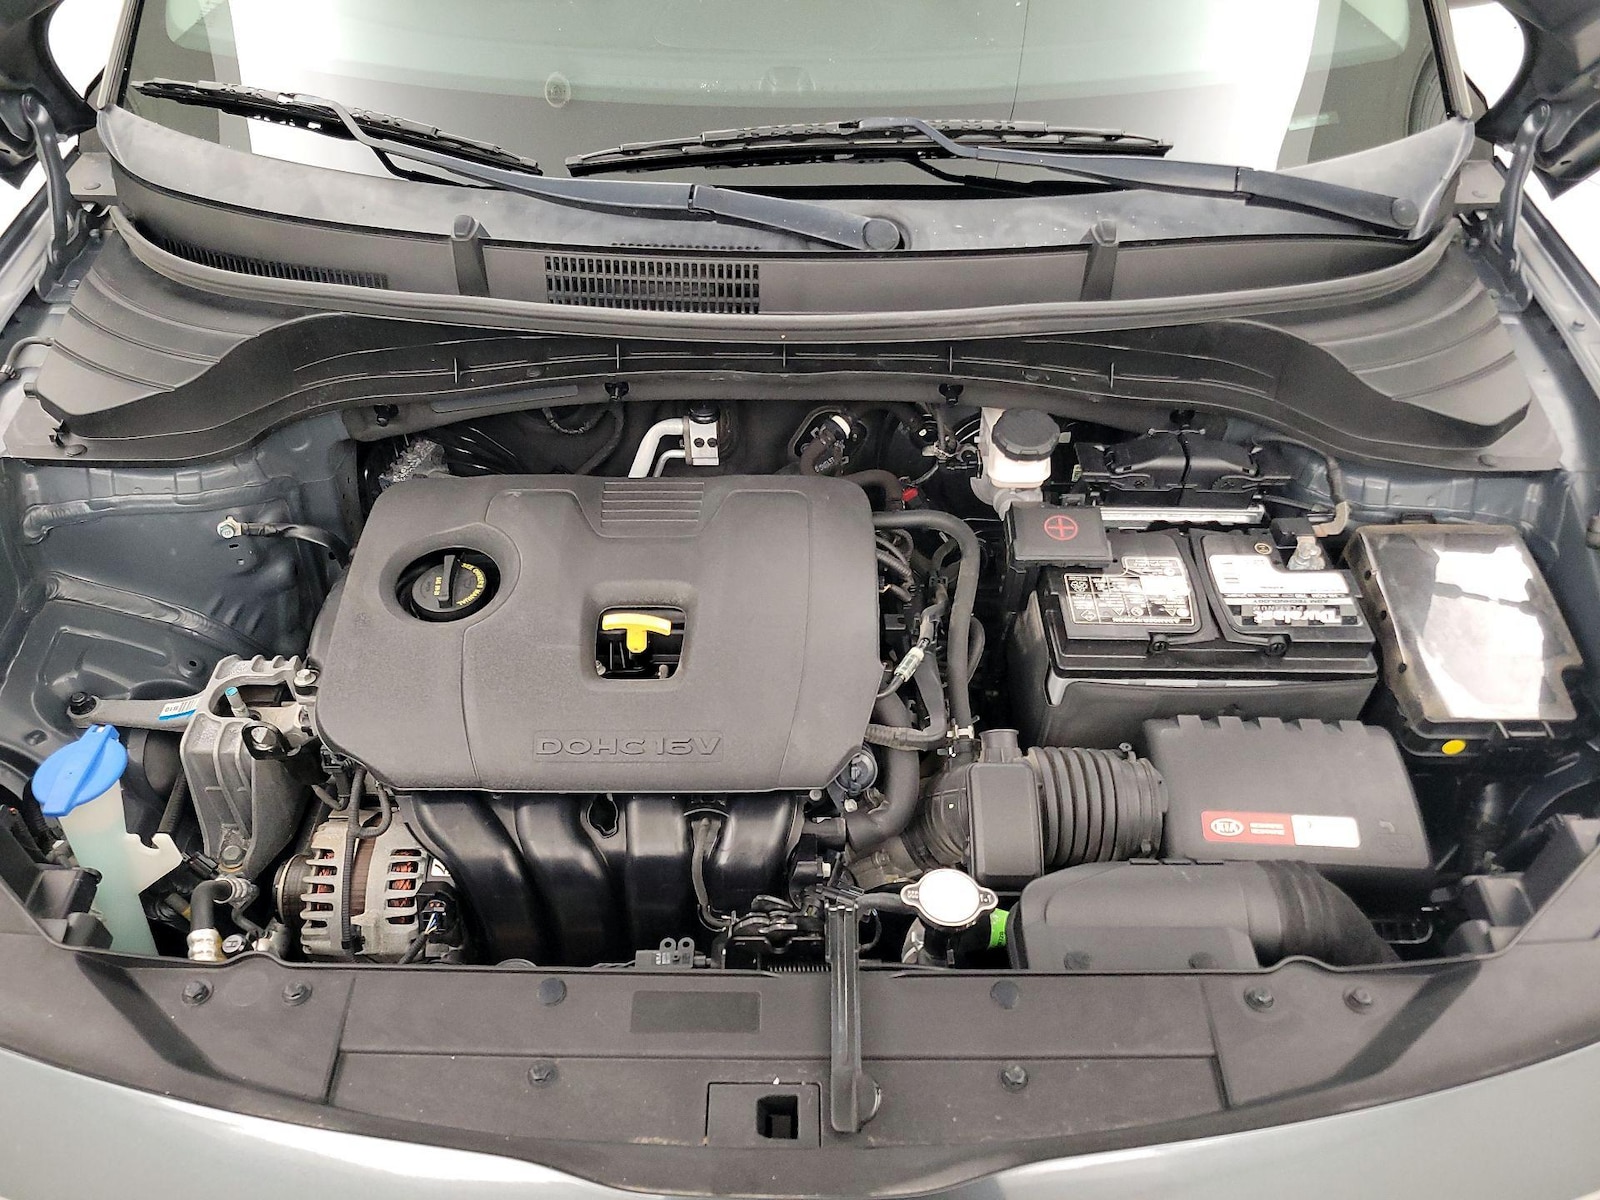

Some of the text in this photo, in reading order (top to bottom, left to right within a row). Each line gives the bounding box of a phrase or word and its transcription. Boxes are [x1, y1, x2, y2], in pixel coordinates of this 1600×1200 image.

[455, 589, 481, 606] MANUAL
[1253, 608, 1341, 624] Duralast
[536, 737, 722, 755] DOHC 16V
[1215, 820, 1240, 834] KIA
